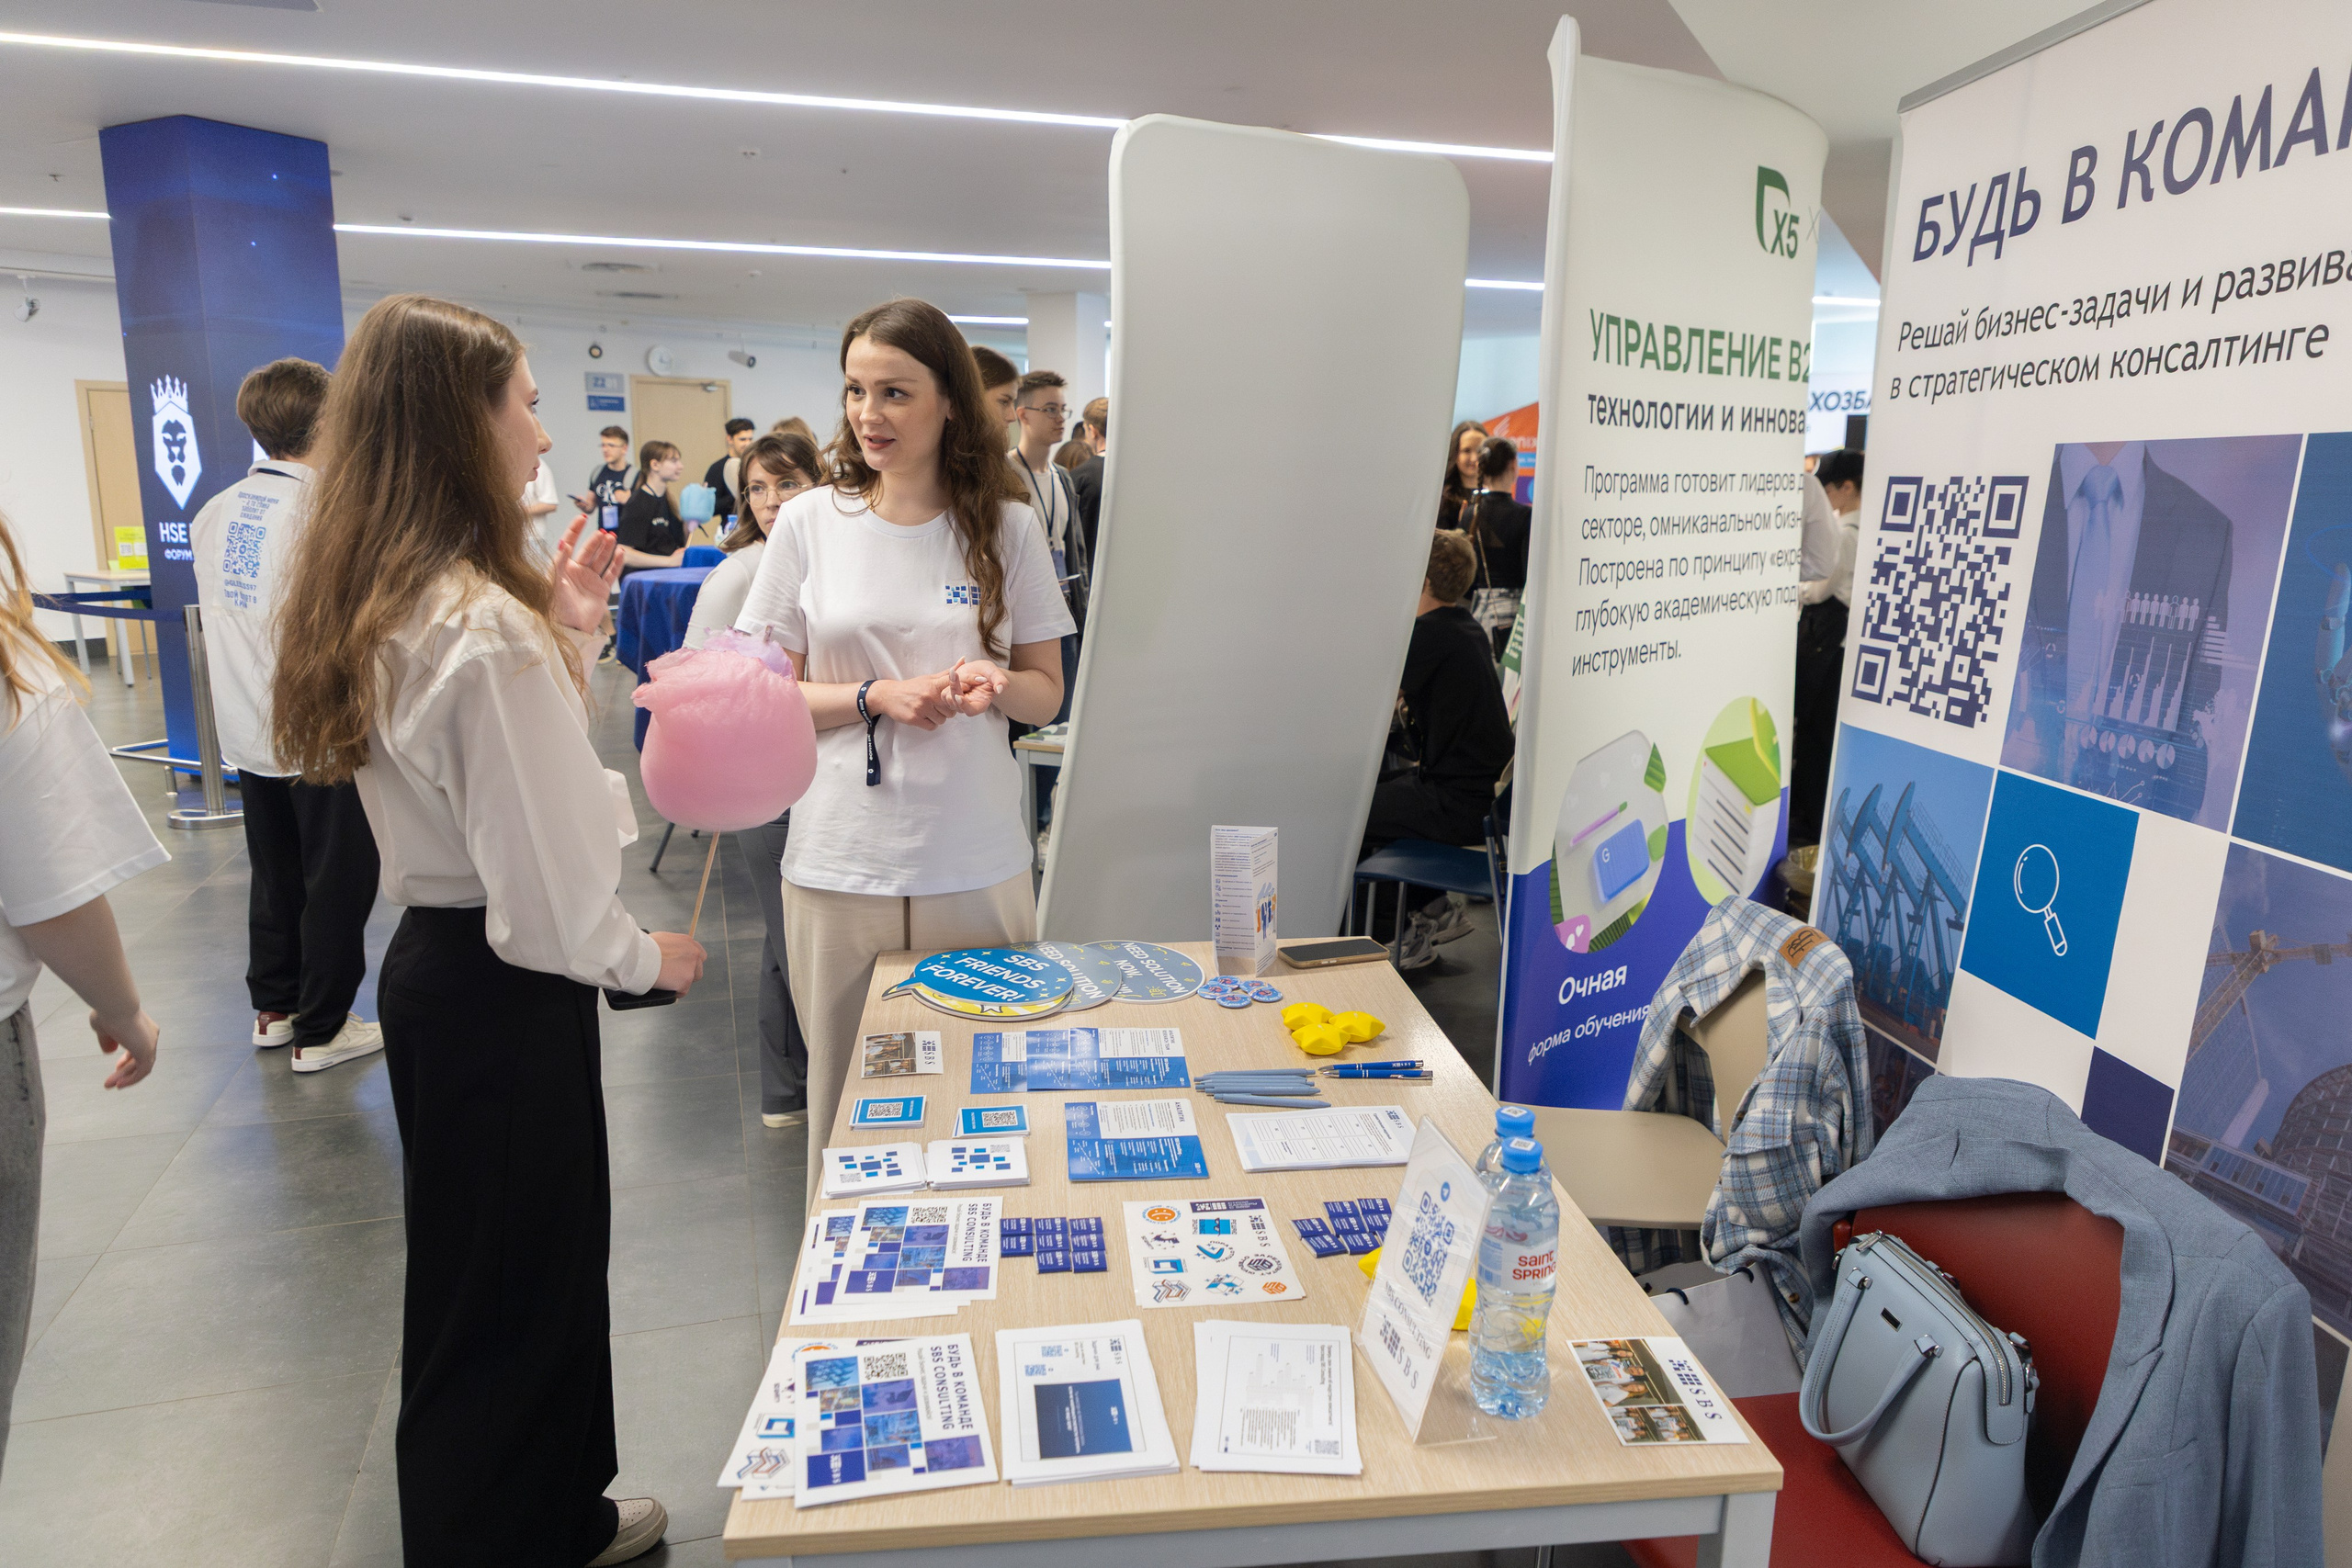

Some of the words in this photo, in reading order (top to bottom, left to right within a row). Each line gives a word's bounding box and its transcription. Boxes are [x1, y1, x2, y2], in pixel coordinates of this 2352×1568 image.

[1912, 166, 2042, 268] БУДЬ
[2061, 145, 2098, 225] В
[1770, 209, 1800, 259] X5
[1897, 309, 1969, 352] Решай
[1974, 280, 2171, 341] бизнес-задачи
[2181, 276, 2203, 309] и
[1589, 308, 1782, 380] УПРАВЛЕНИЕ
[1890, 376, 1901, 400] в
[1908, 353, 2100, 405] стратегическом
[2109, 323, 2330, 380] консалтинге
[1588, 394, 1714, 432] технологии
[1721, 405, 1734, 431] и
[1741, 406, 1805, 434] иннова
[1584, 465, 1669, 501] Программа
[1674, 472, 1736, 493] готовит
[1739, 473, 1796, 497] лидеров
[159, 521, 188, 543] HSE
[1582, 517, 1646, 544] секторе,
[1650, 513, 1771, 536] омниканальном
[1579, 558, 1663, 589] Построена
[1669, 558, 1688, 577] по
[1693, 551, 1766, 581] принципу
[1575, 599, 1650, 636] глубокую
[1654, 587, 1772, 621] академическую
[1572, 640, 1682, 677] инструменты.
[1003, 954, 1051, 973] SBS
[1034, 942, 1063, 962] NEED
[1120, 942, 1149, 964] NEED
[1141, 958, 1188, 994] SOLUTION
[921, 964, 1025, 1002] FOREVER!
[954, 957, 1046, 990] FRIENDS
[1558, 964, 1628, 1005] Очная
[1527, 1023, 1571, 1066] форма
[1574, 1004, 1651, 1040] обучения
[968, 1203, 978, 1215] SBS
[980, 1203, 992, 1220] БУДЬ
[963, 1217, 976, 1261] CONSULTING
[976, 1229, 989, 1262] КОМАНДЕ
[1256, 1231, 1270, 1247] SBS
[1512, 1261, 1556, 1280] SPRING
[1518, 1250, 1554, 1267] saint
[931, 1346, 943, 1363] SBS
[1398, 1352, 1419, 1390] SBS
[934, 1366, 954, 1430] CONSULTING
[947, 1344, 961, 1368] БУДЬ
[954, 1381, 973, 1430] КОМАНДЕ
[1690, 1388, 1723, 1420] SBS
[832, 1467, 840, 1484] SBS
